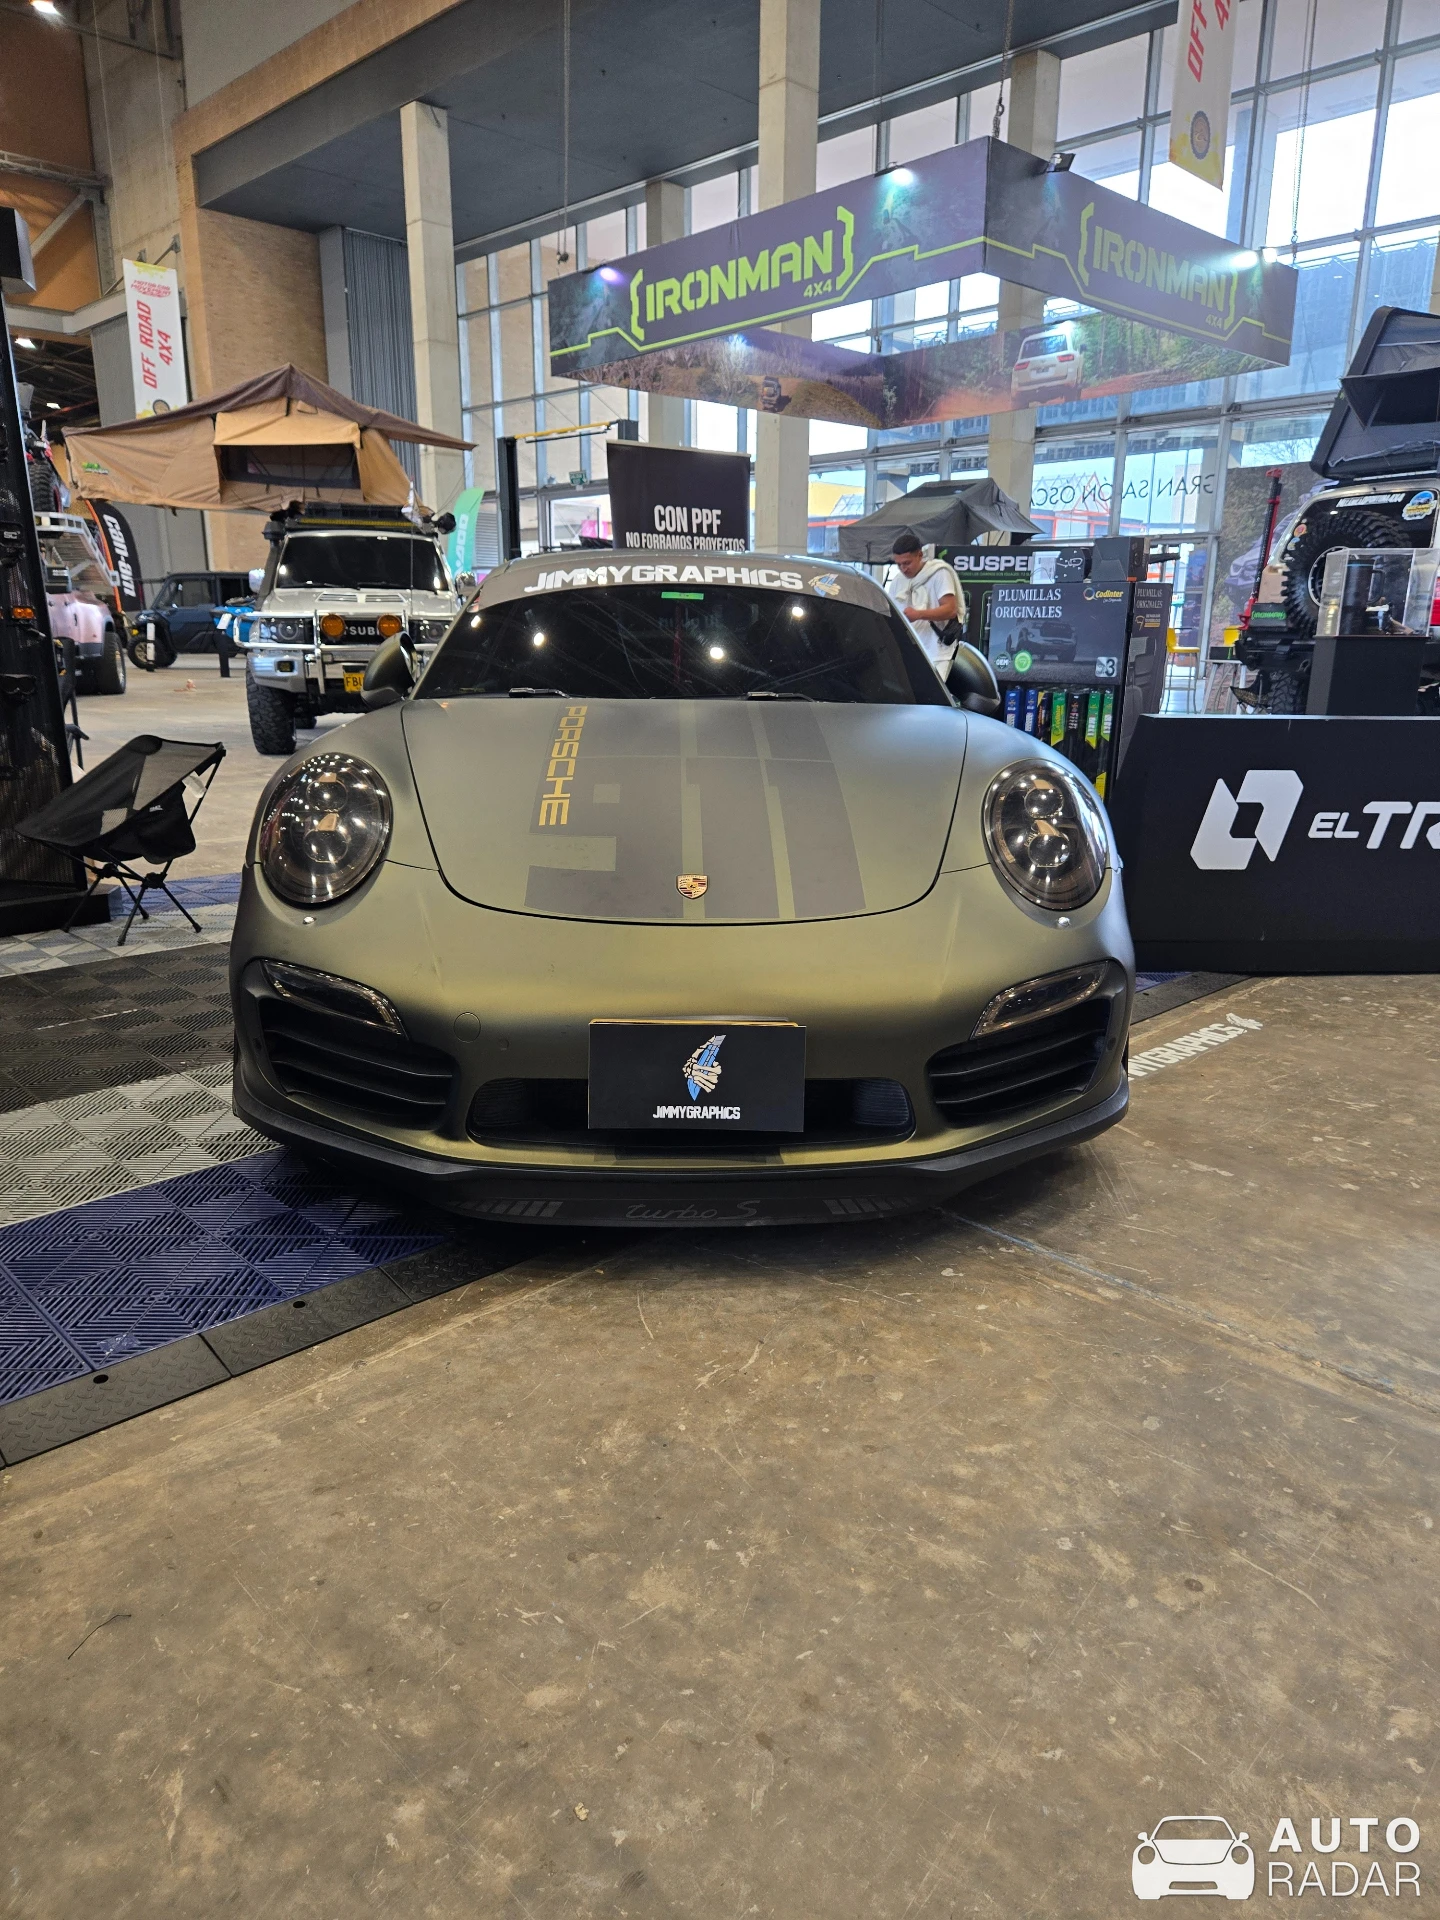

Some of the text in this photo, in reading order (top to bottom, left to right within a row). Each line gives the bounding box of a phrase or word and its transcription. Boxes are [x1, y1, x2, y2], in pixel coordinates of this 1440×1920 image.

[646, 230, 833, 322] IRONMAN
[1093, 225, 1226, 312] IRONMAN
[803, 278, 832, 299] 4X4
[1205, 314, 1222, 328] 4X4
[136, 300, 158, 390] OFF ROAD
[157, 330, 173, 366] 4X4
[654, 504, 722, 535] CON PPF
[625, 531, 746, 552] NO FORRAMOS PROYECTOS
[524, 564, 804, 593] JIMMYGRAPHICS
[998, 588, 1062, 602] PLUMILLAS
[995, 605, 1063, 619] ORIGINALES
[1105, 658, 1116, 677] 3
[539, 705, 588, 826] PORSCHE
[1308, 812, 1359, 838] EL
[1362, 801, 1440, 850] TR
[652, 1105, 741, 1120] JIMMYGRAPHICS
